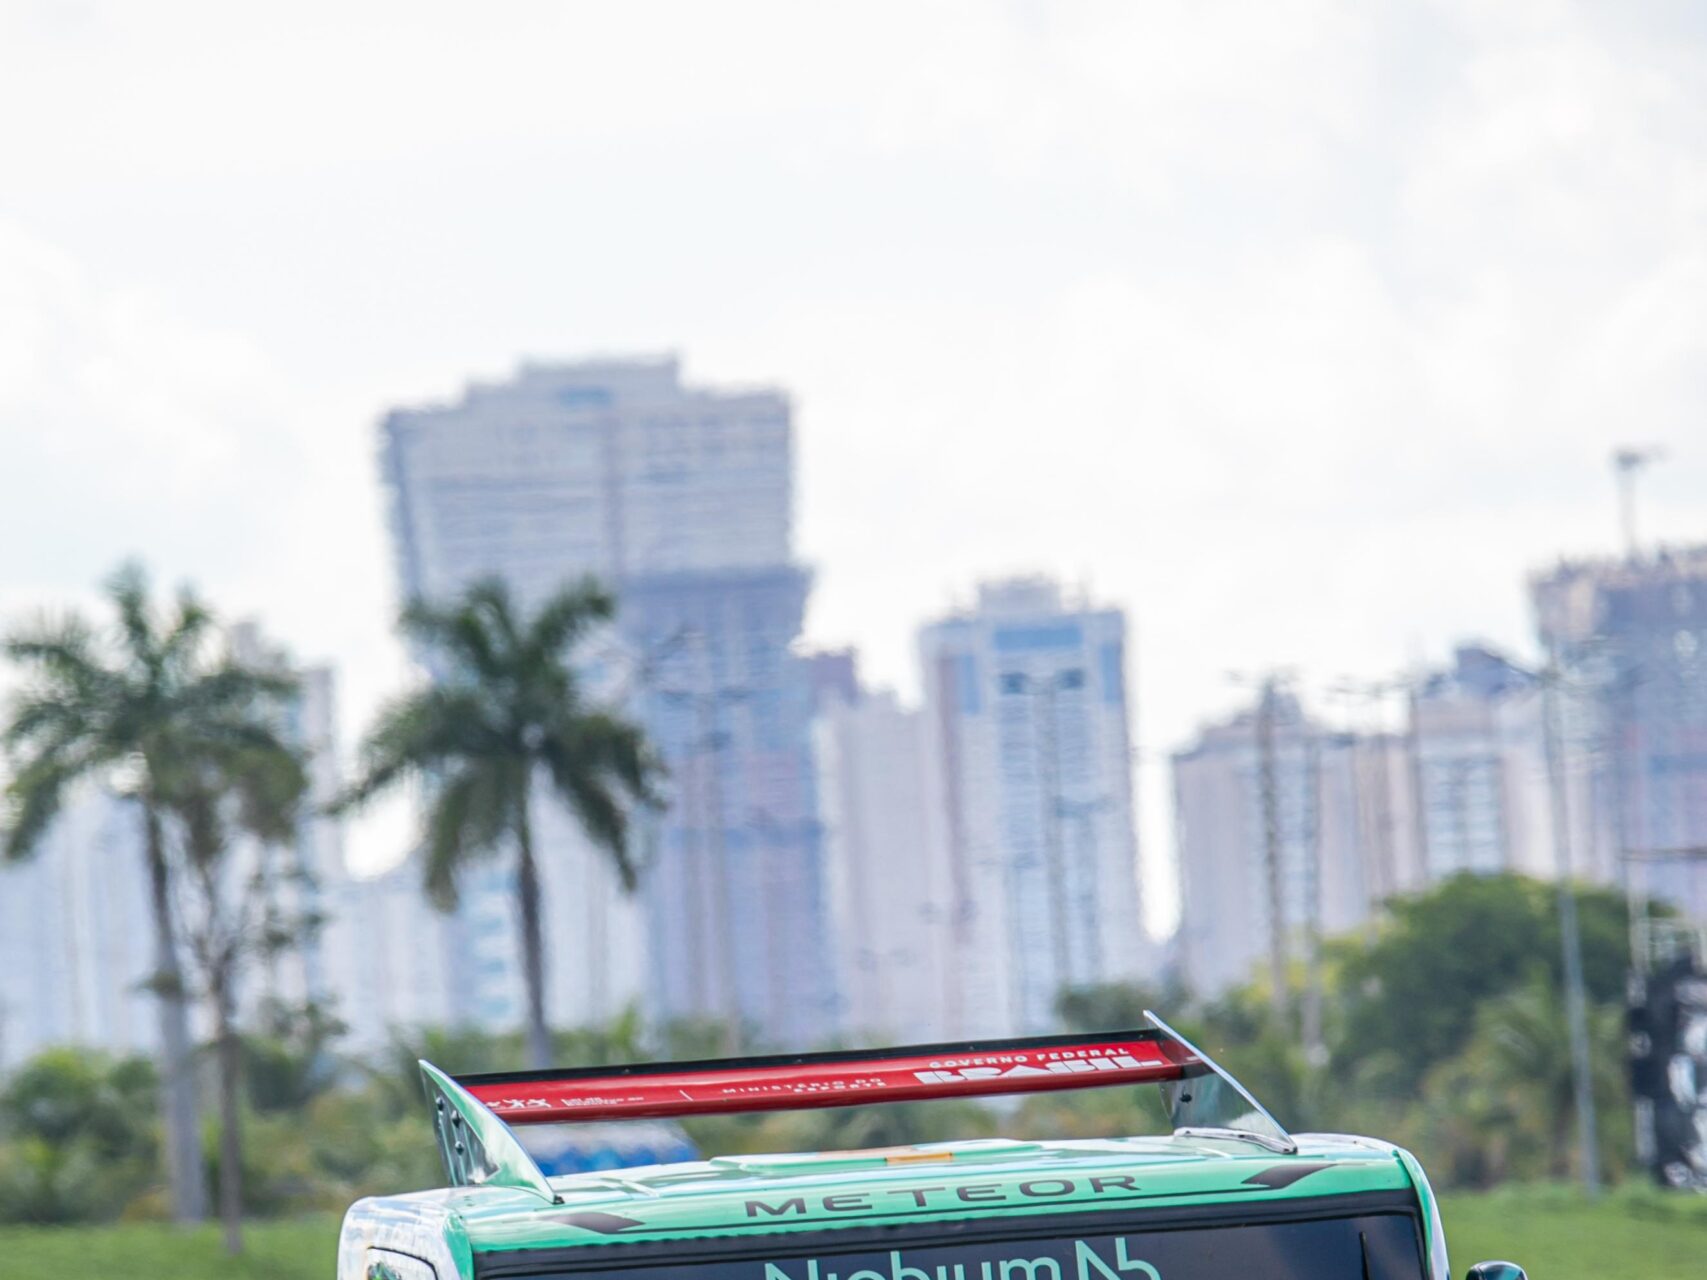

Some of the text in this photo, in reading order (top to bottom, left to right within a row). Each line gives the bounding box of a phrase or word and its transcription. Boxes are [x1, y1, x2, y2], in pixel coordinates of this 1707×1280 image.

[913, 1056, 1163, 1084] BRASIL
[929, 1048, 1129, 1068] GOVERNO FEDERAL
[747, 1175, 1141, 1217] METEOR
